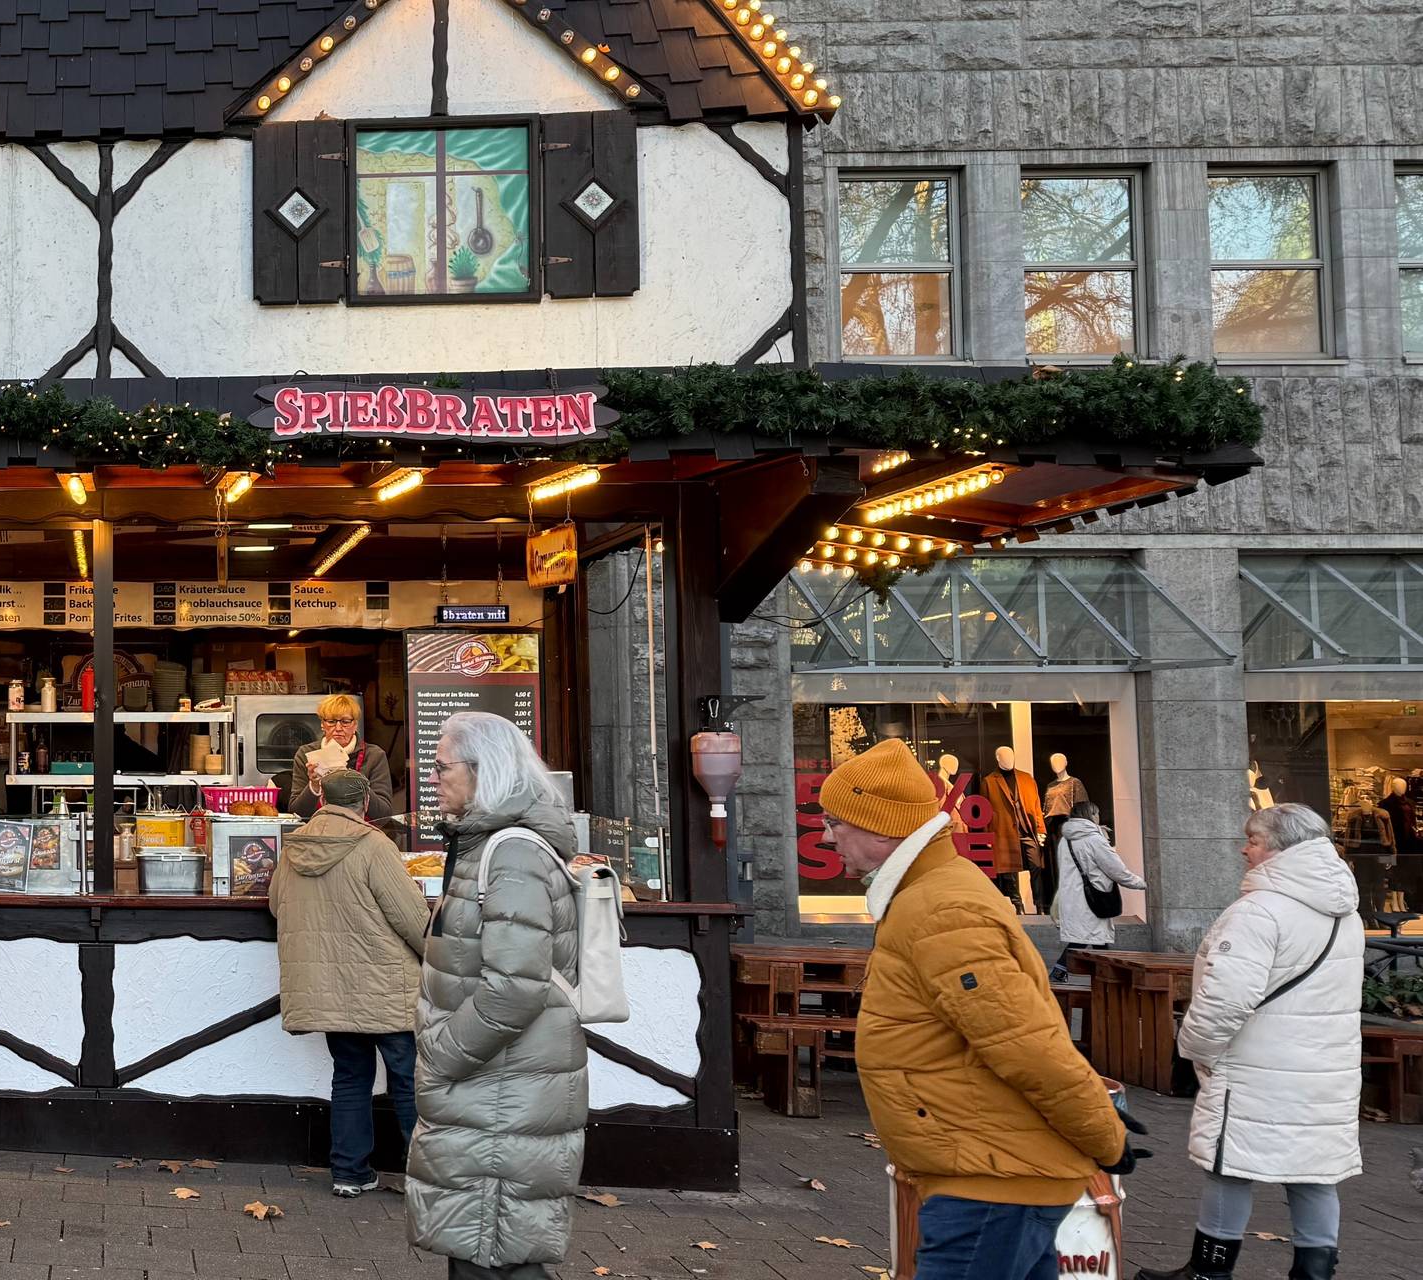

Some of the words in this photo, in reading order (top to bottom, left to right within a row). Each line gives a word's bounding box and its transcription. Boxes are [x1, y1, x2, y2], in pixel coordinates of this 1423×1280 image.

[179, 584, 246, 594] Kräutersauce
[294, 585, 324, 594] Sauce
[179, 598, 262, 608] Knoblauchsauce
[294, 599, 337, 610] Ketchup
[114, 613, 142, 623] Frites
[179, 613, 237, 624] Mayonnaise
[239, 612, 261, 622] 50%
[487, 610, 506, 620] mit
[797, 832, 997, 880] SE
[1057, 1250, 1110, 1277] hnell
